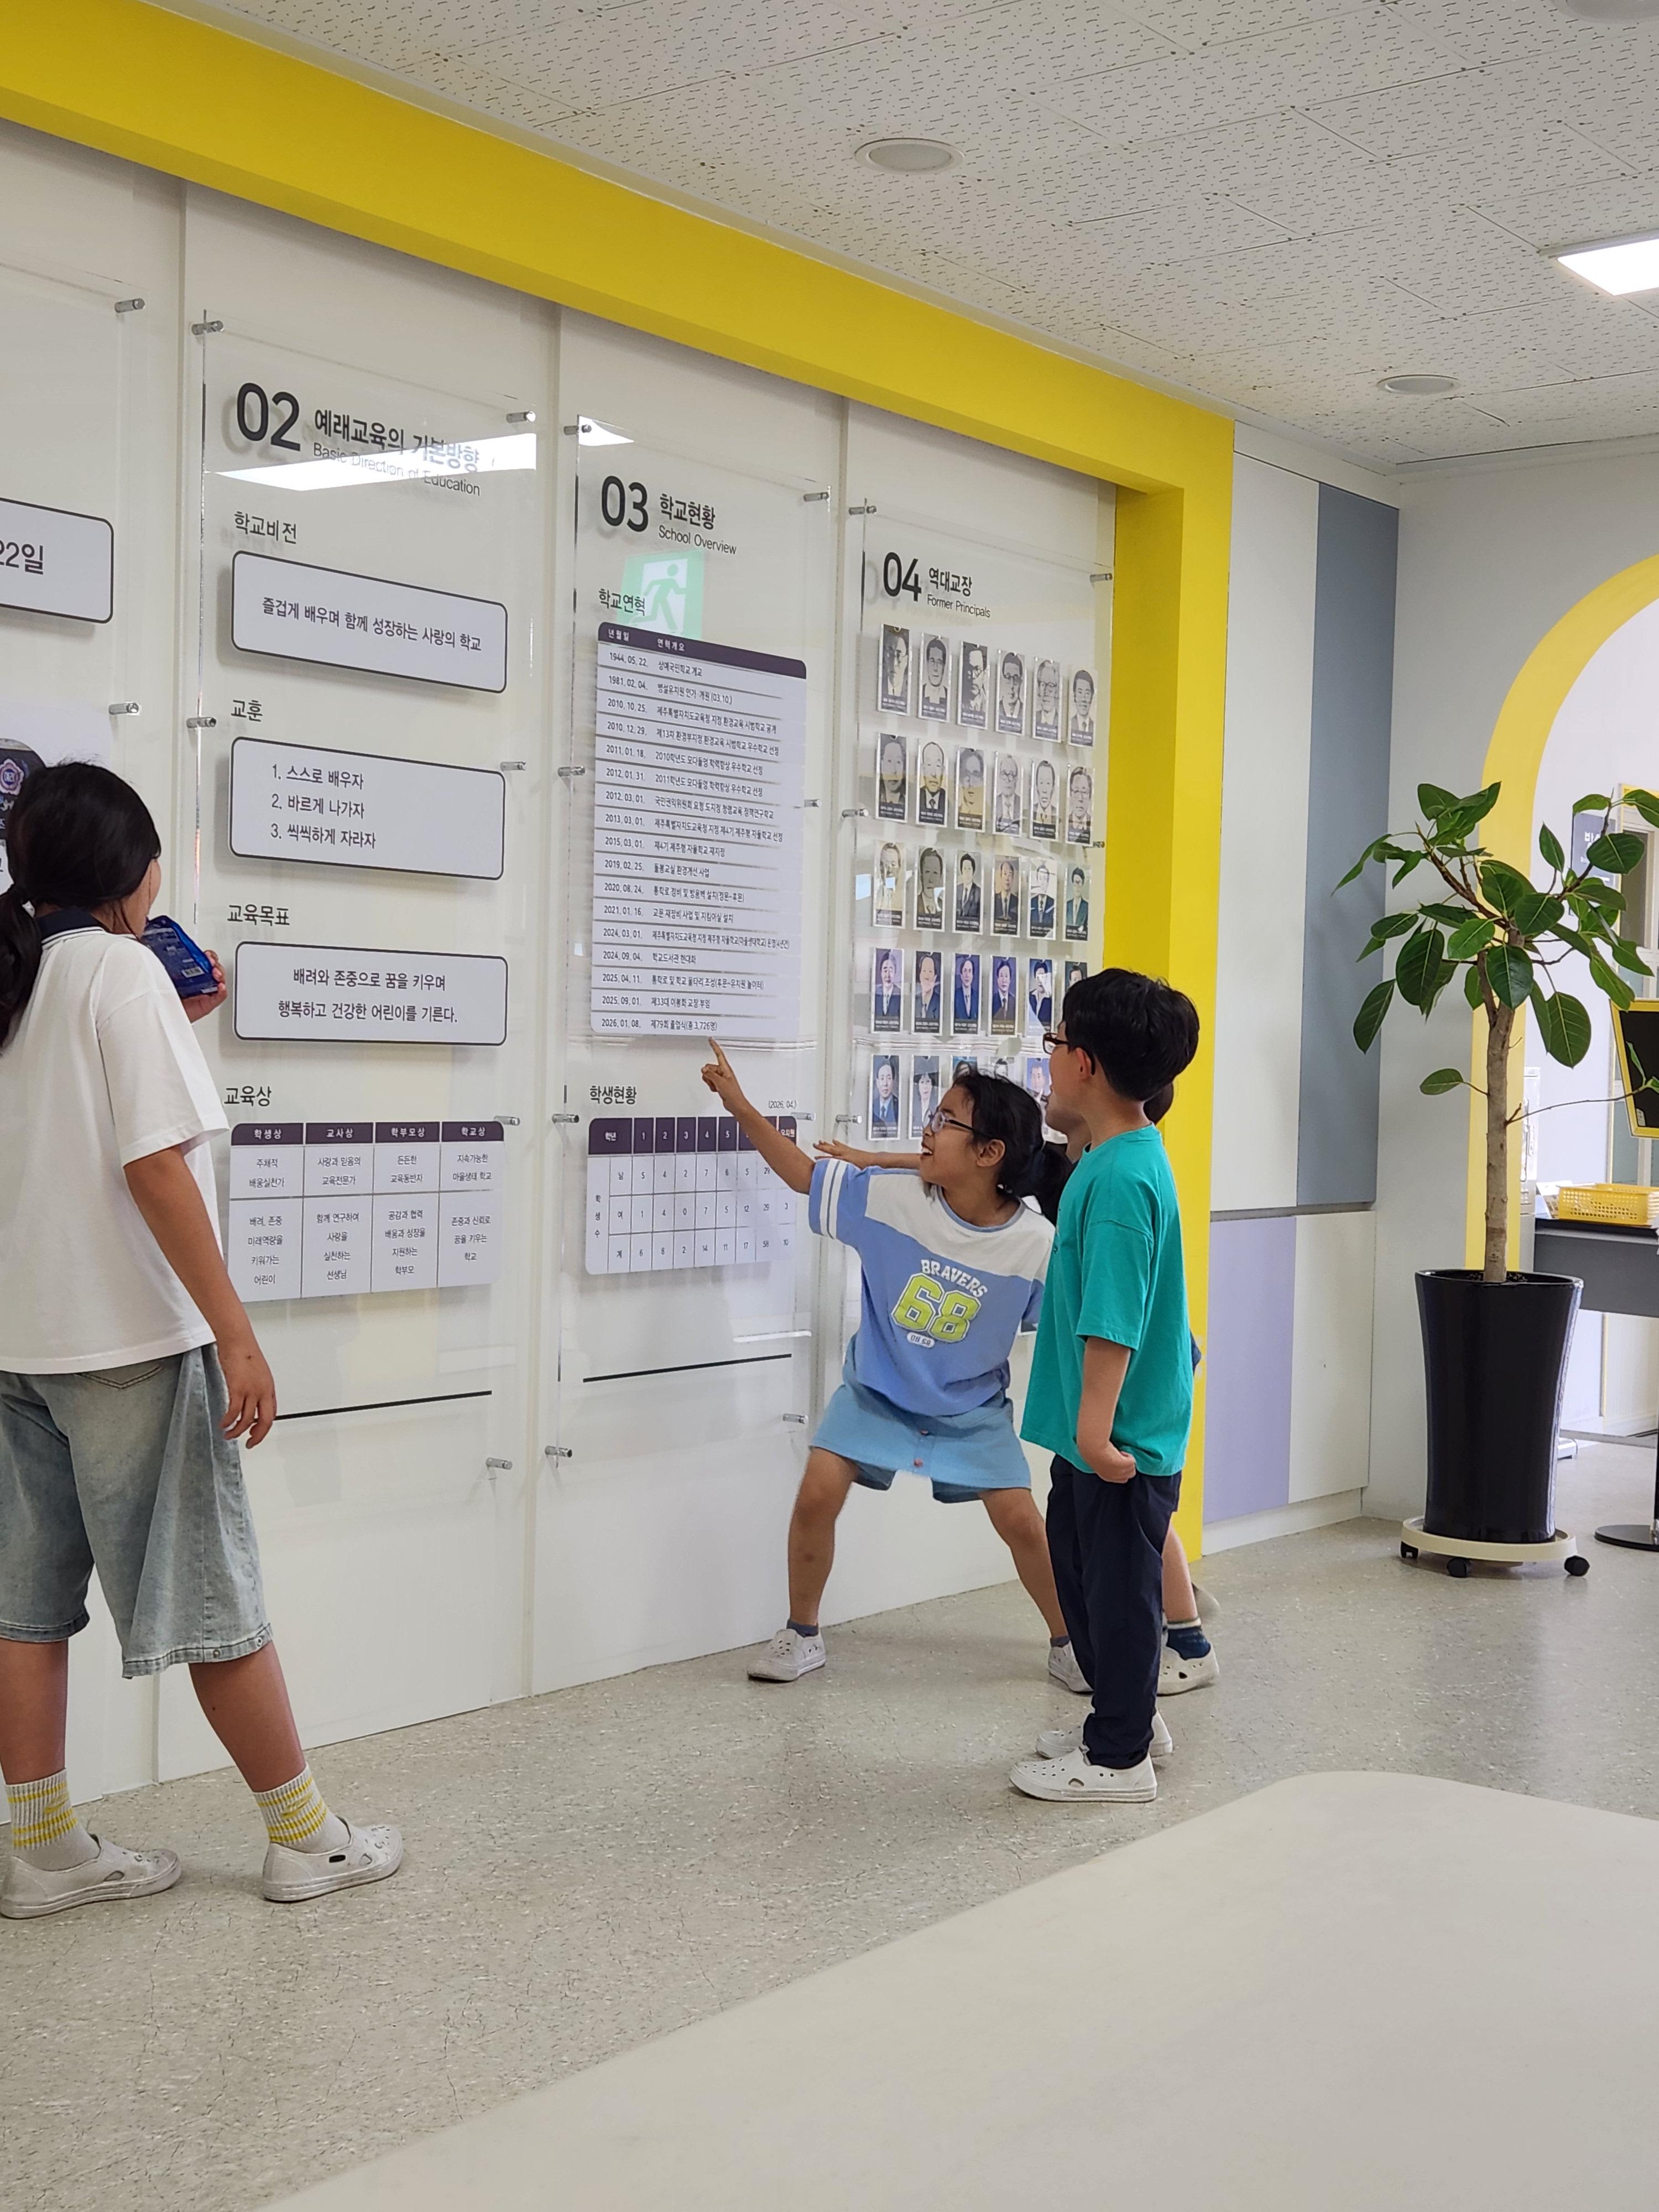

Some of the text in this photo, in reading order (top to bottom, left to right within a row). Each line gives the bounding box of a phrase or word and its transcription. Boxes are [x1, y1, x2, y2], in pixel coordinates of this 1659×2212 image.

[237, 382, 480, 472] 02 예래교육의 기본방향
[314, 442, 347, 462] Basic
[351, 452, 404, 477] Direction
[424, 470, 480, 496] Education
[602, 476, 716, 532] 03 학교현황
[234, 511, 297, 545] 학교비전
[659, 525, 737, 555] School Overview
[884, 552, 972, 602] 04 역대교장
[599, 588, 645, 616] 학교연혁
[927, 594, 990, 618] Former Principals
[263, 597, 482, 651] 즐겁게 배우며 함께 성장하는 사랑의 학교
[609, 653, 626, 663] 1944.
[609, 676, 625, 686] 1981.
[608, 698, 625, 710] 2010.
[231, 700, 263, 722] 교훈
[607, 721, 624, 732] 2010.
[606, 744, 624, 755] 2011.
[272, 764, 364, 790] 1. 스스로 배우자
[272, 794, 364, 819] 2. 바르게 나가자
[606, 813, 622, 824] 2013.
[271, 823, 376, 849] 3. 씩씩하게 자라자
[606, 837, 623, 847] 2015.
[605, 859, 622, 869] 2019.
[604, 883, 622, 893] 2020.
[227, 904, 290, 926] 교육목표
[604, 905, 621, 915] 2021.
[293, 968, 446, 991] 배려와 존중으로 꿈을 키우며
[603, 973, 620, 983] 2025.
[602, 996, 619, 1005] 2025.
[279, 1001, 458, 1024] 행복하고 건강한 어린이를 기른다.
[602, 1019, 619, 1027] 2026.
[224, 1086, 272, 1107] 교육상
[589, 1086, 637, 1104] 학생현황
[254, 1128, 281, 1140] 학생상
[326, 1128, 353, 1139] 교사상
[392, 1127, 425, 1137] 학부모상
[461, 1126, 485, 1136] 학교상
[257, 1158, 278, 1168] 주체적
[318, 1156, 361, 1166] 사랑과 믿음의
[398, 1155, 416, 1165] 든든한
[457, 1154, 488, 1163] 지속가능한
[322, 1176, 356, 1186] 교육전문가
[390, 1175, 422, 1183] 교육동반자
[453, 1172, 492, 1181] 마을생태 학교
[249, 1178, 284, 1188] 배움실천가
[268, 1216, 282, 1225] 존중
[317, 1212, 359, 1223] 함께 연구하여
[389, 1211, 408, 1220] 공감과
[452, 1216, 490, 1225] 존중과 신뢰로
[327, 1232, 347, 1241] 사랑을
[385, 1227, 425, 1238] 배움과 성장을
[248, 1236, 283, 1245] 미래역량을
[469, 1234, 487, 1243] 키우는
[324, 1251, 351, 1261] 실천하는
[392, 1247, 418, 1256] 지원하는
[252, 1256, 279, 1265] 키워가는
[465, 1253, 477, 1261] 학교
[327, 1270, 347, 1280] 선생님
[395, 1266, 414, 1275] 학부모
[254, 1275, 275, 1285] 어린이
[921, 1259, 988, 1297] BRAVERS
[891, 1272, 982, 1343] 68
